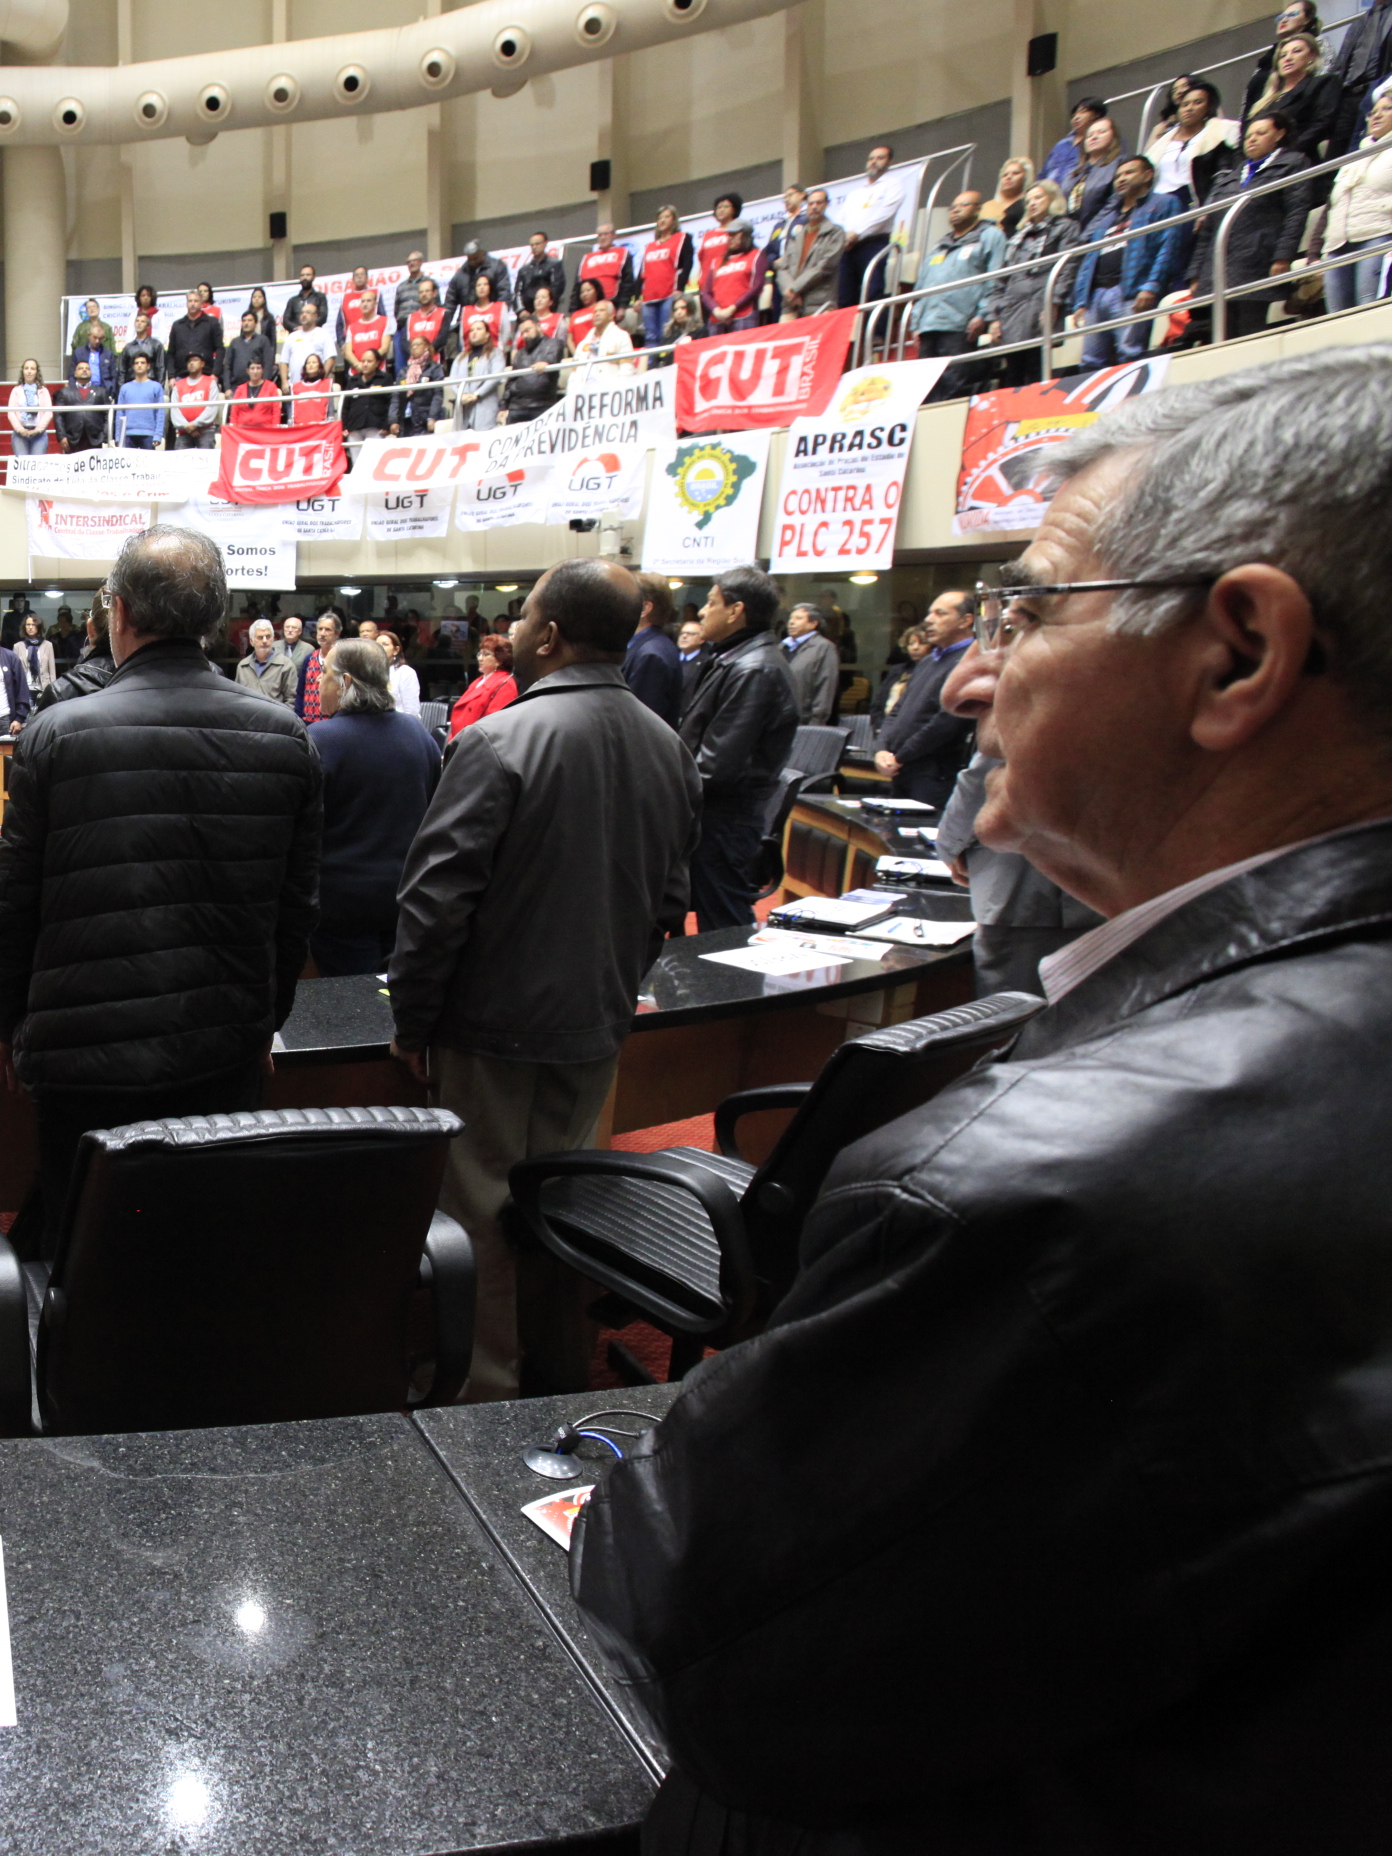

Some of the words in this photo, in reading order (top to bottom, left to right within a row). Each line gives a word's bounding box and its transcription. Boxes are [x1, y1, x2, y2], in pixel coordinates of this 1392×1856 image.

[699, 342, 805, 403] CUT
[798, 333, 823, 400] BRASIL
[573, 380, 664, 422] REFORMA
[794, 422, 909, 458] APRASC
[73, 457, 86, 473] de
[239, 444, 323, 482] CUT
[322, 442, 335, 478] RASIL
[372, 442, 481, 482] CUT
[12, 475, 51, 485] Sindicato
[568, 474, 619, 492] UGT
[690, 481, 719, 490] BRASIL
[476, 482, 523, 502] UGT
[783, 483, 875, 517] CONTRA
[884, 480, 901, 510] O
[296, 498, 341, 513] UGT
[385, 493, 428, 511] UGT
[54, 513, 146, 527] INTERSINDICAL
[54, 527, 77, 535] Central
[778, 520, 830, 558] PLC
[837, 517, 896, 556] 257
[226, 543, 276, 556] Somos
[682, 536, 715, 549] CNTI
[225, 565, 268, 577] ortes!
